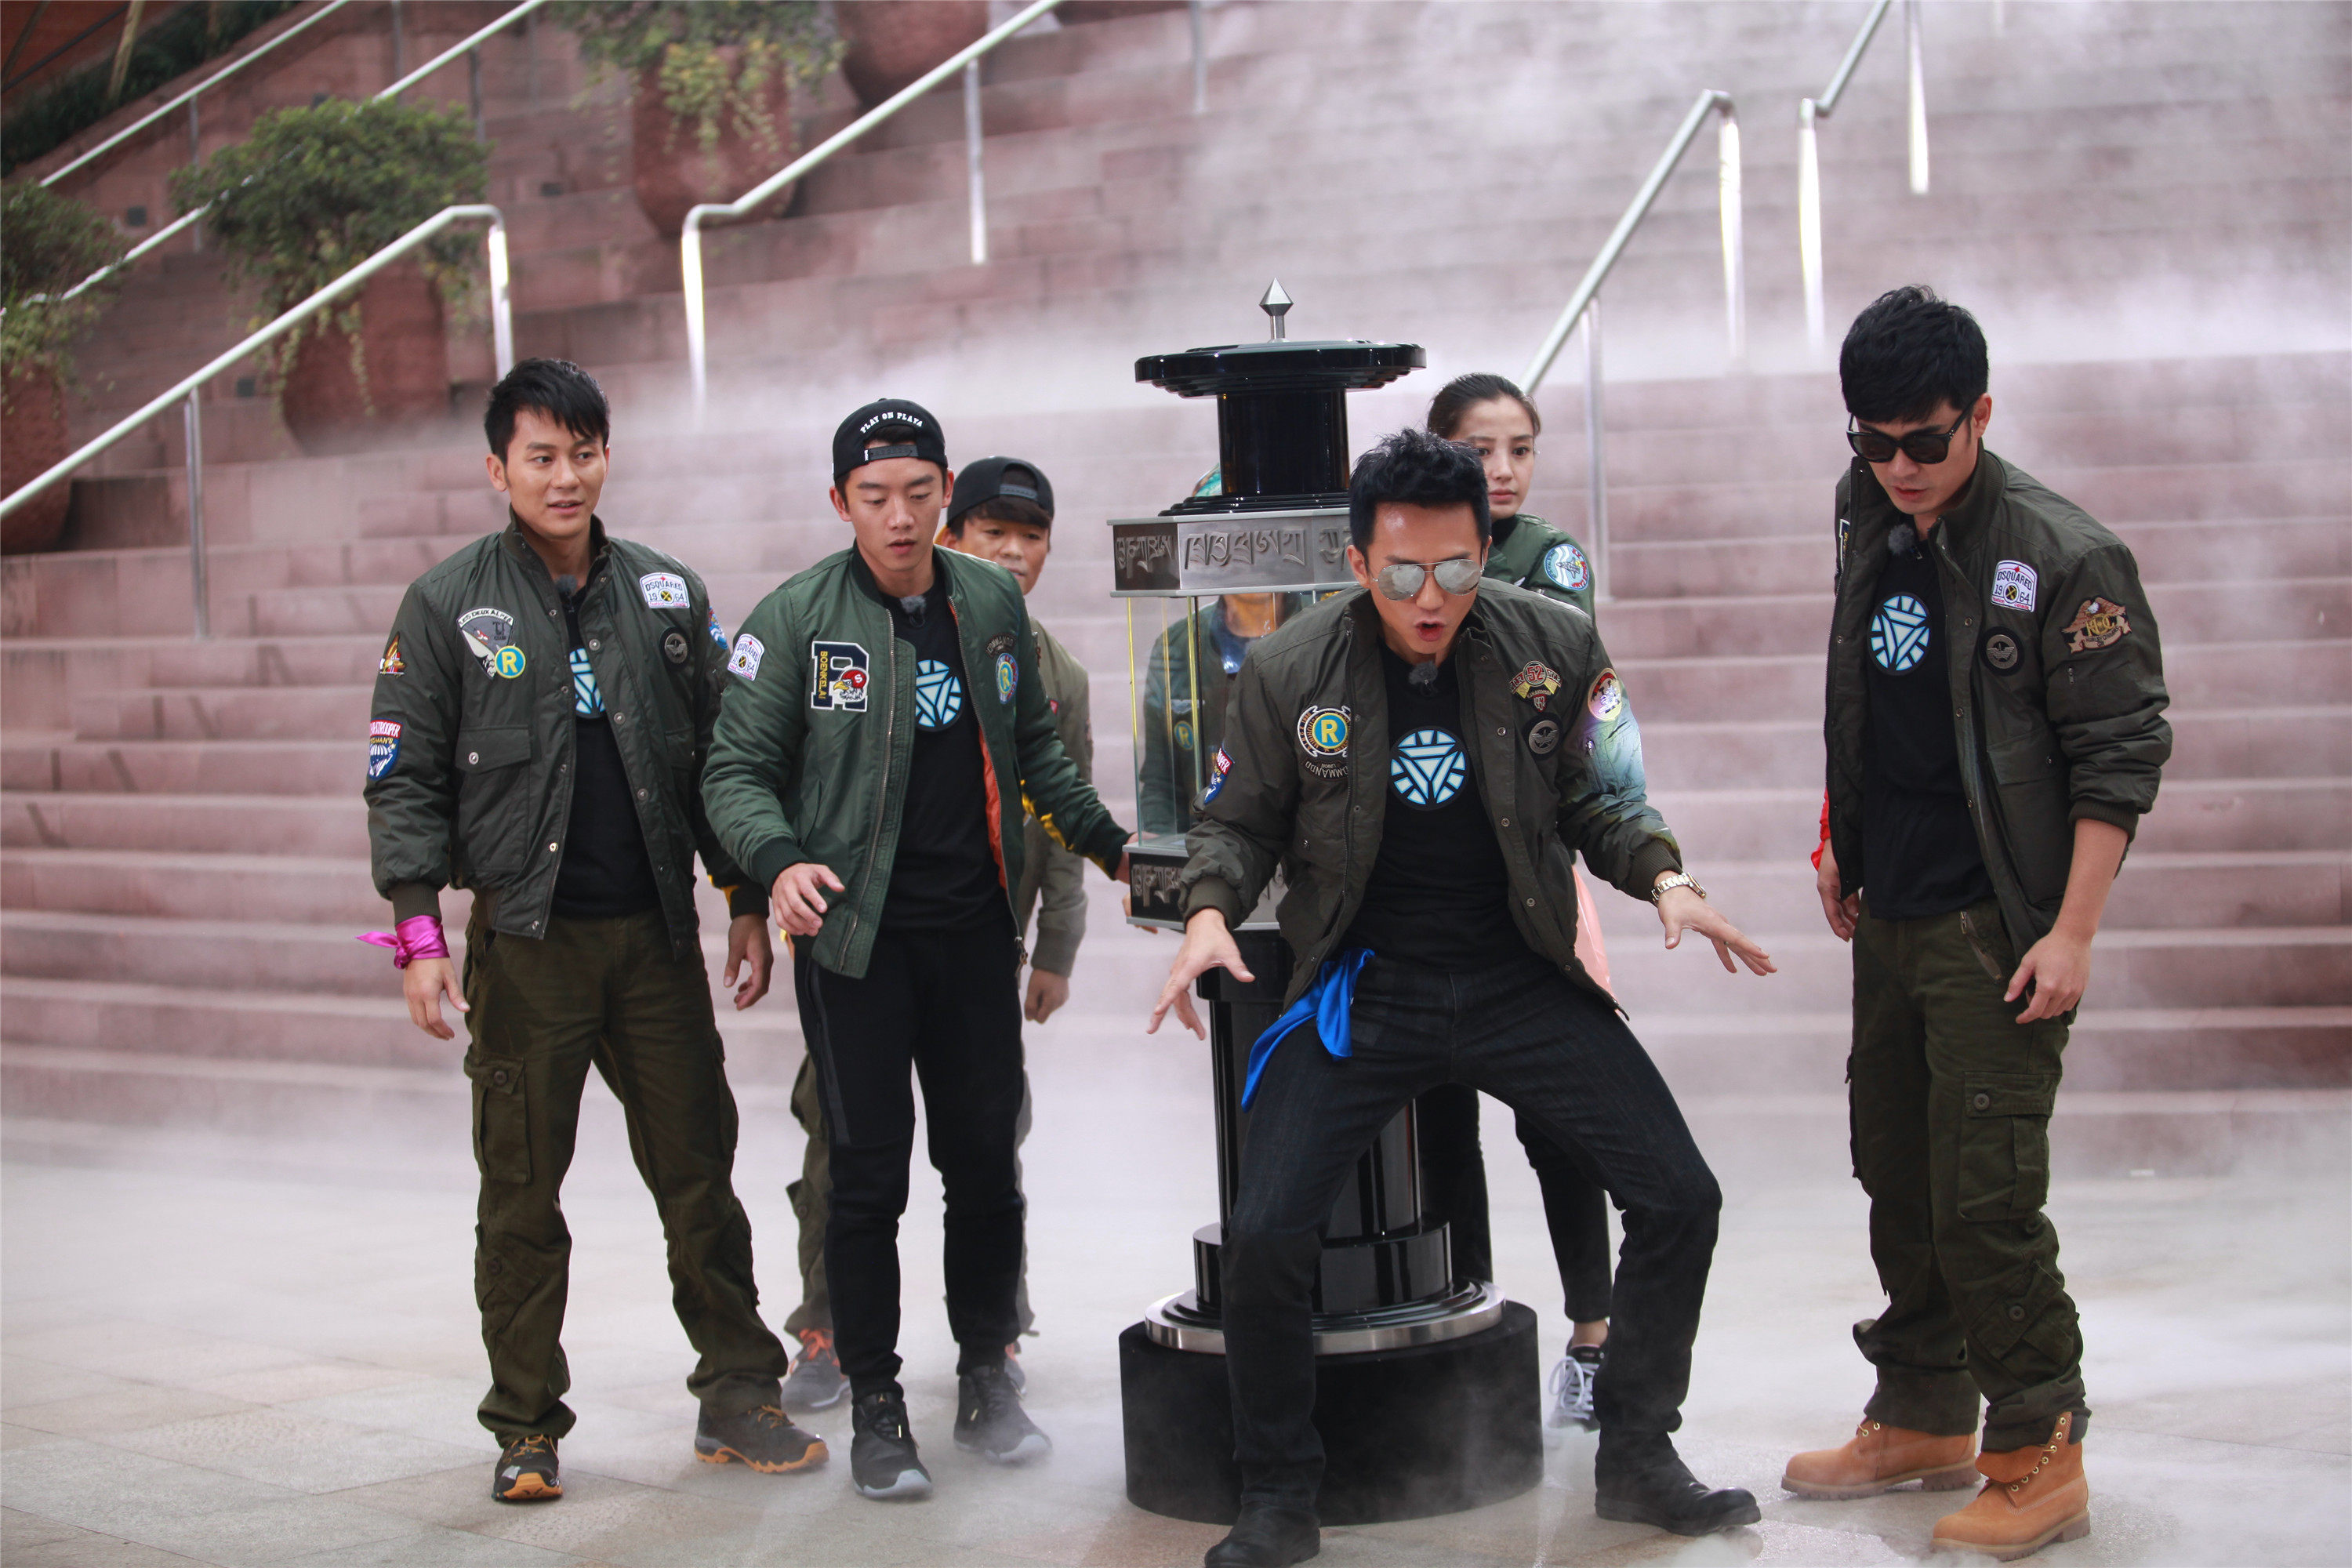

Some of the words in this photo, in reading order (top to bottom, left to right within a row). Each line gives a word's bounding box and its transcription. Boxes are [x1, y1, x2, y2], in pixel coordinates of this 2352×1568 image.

[860, 416, 879, 434] PLAY
[882, 412, 894, 420] ON
[896, 412, 924, 427] PLAYA
[645, 580, 683, 592] DSQUARED
[1997, 571, 2033, 591] DSQUARED
[1994, 584, 2003, 595] 19
[2020, 592, 2030, 604] 64
[502, 652, 518, 673] R
[854, 673, 863, 684] S
[1000, 667, 1011, 690] R
[1527, 665, 1544, 682] 52
[1178, 726, 1191, 746] R
[1320, 719, 1339, 743] R
